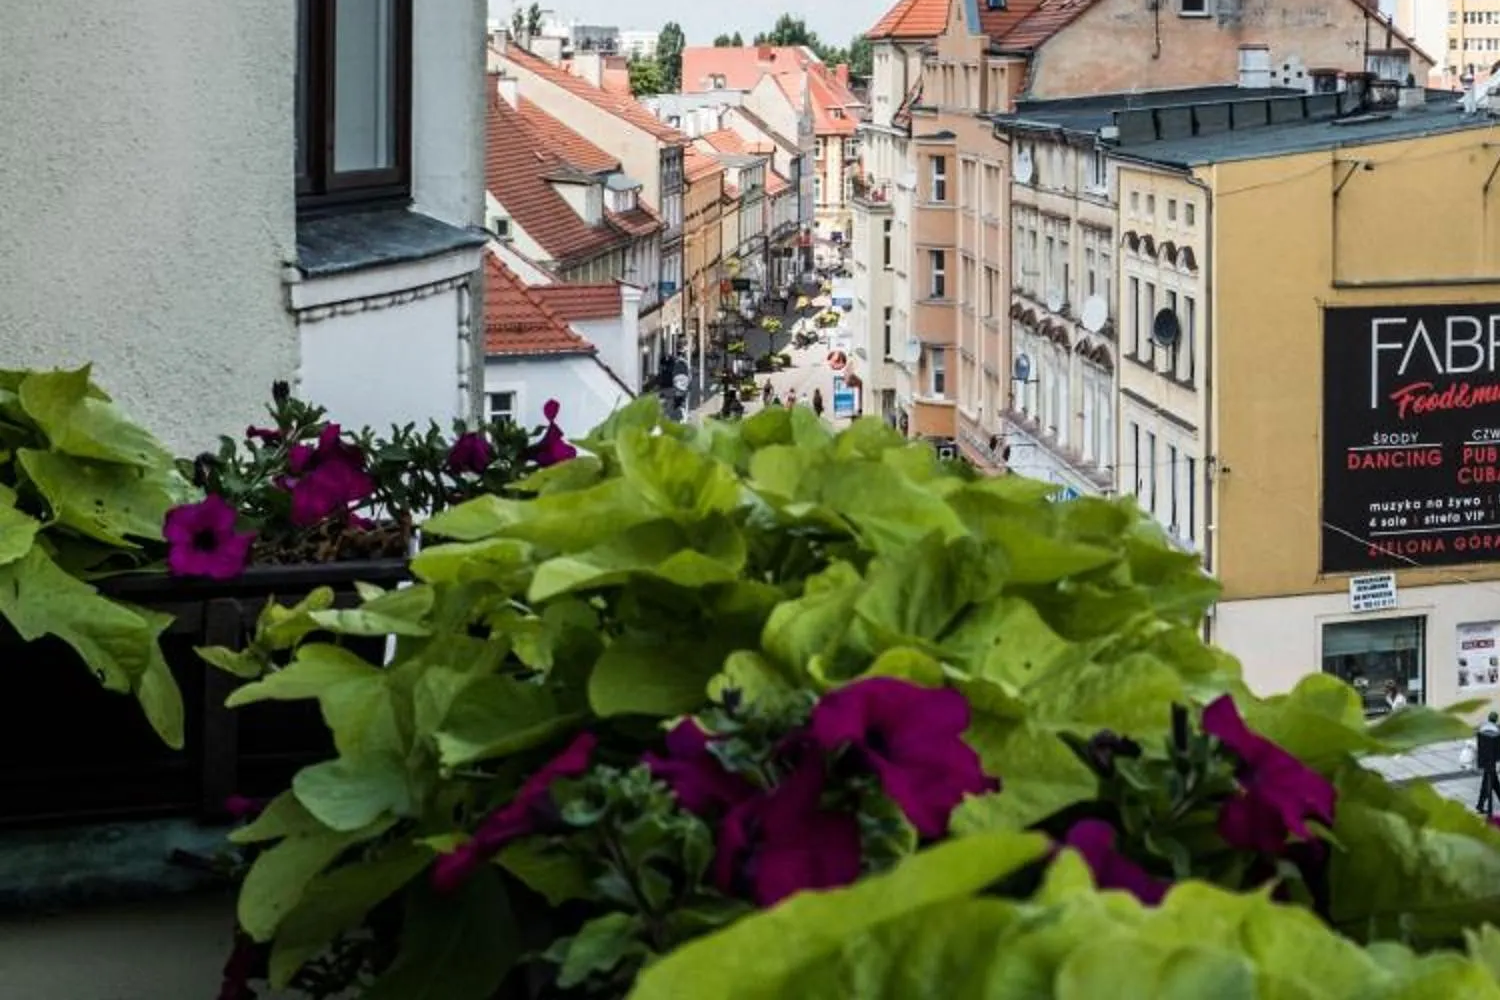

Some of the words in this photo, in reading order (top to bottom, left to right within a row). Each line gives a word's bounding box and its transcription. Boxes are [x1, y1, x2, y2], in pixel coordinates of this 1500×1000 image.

[1372, 431, 1419, 445] ŚRODY
[1347, 449, 1443, 470] DANCING
[1463, 447, 1497, 464] PUB
[1369, 499, 1421, 513] muzyka
[1426, 499, 1443, 509] na
[1381, 514, 1407, 527] sale
[1424, 512, 1460, 525] strefa
[1464, 510, 1485, 521] VIP
[1368, 539, 1446, 557] ZIELONA
